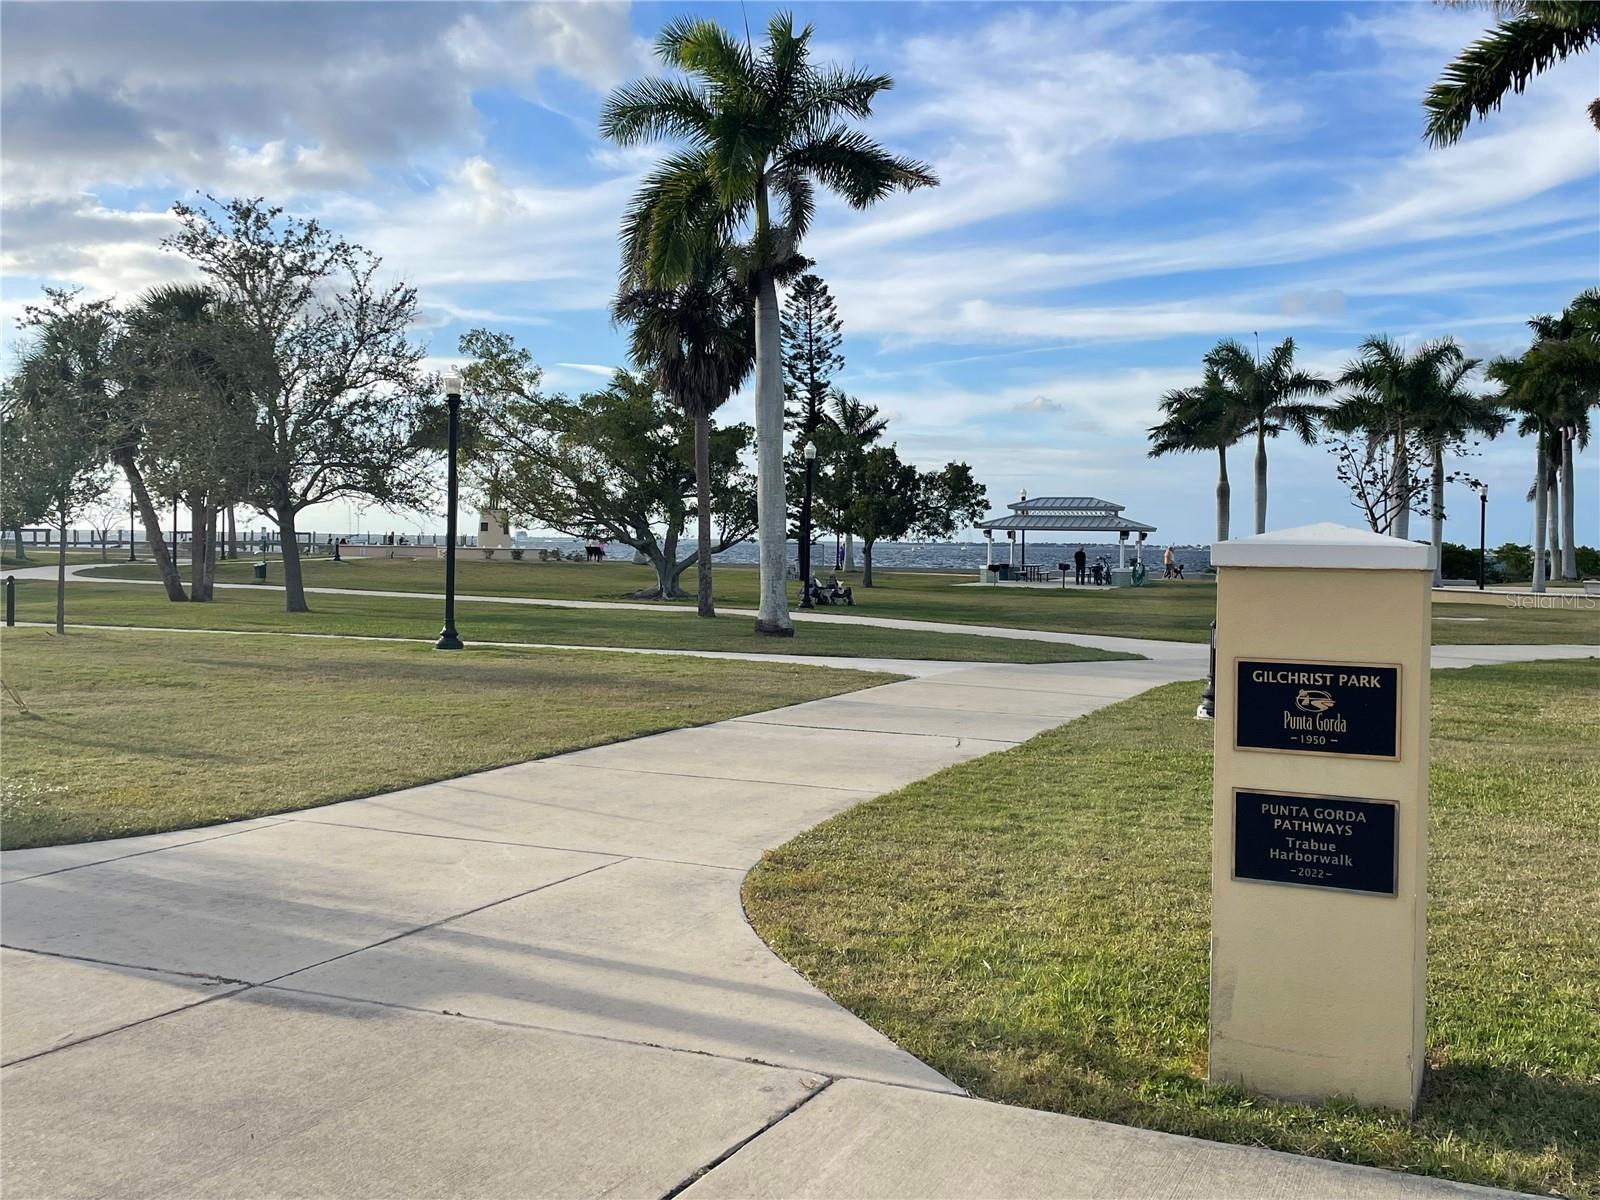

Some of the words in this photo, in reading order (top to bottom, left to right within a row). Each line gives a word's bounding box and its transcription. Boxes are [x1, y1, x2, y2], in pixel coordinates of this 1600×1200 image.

[1252, 670, 1334, 686] GILCHRIST
[1339, 674, 1381, 688] PARK
[1284, 711, 1312, 730] Punta
[1316, 713, 1346, 732] Gorda
[1261, 804, 1309, 818] PUNTA
[1314, 808, 1367, 823] GORDA
[1274, 819, 1353, 836] PATHWAYS
[1285, 837, 1337, 852] Trabue
[1269, 849, 1353, 866] Harborwalk
